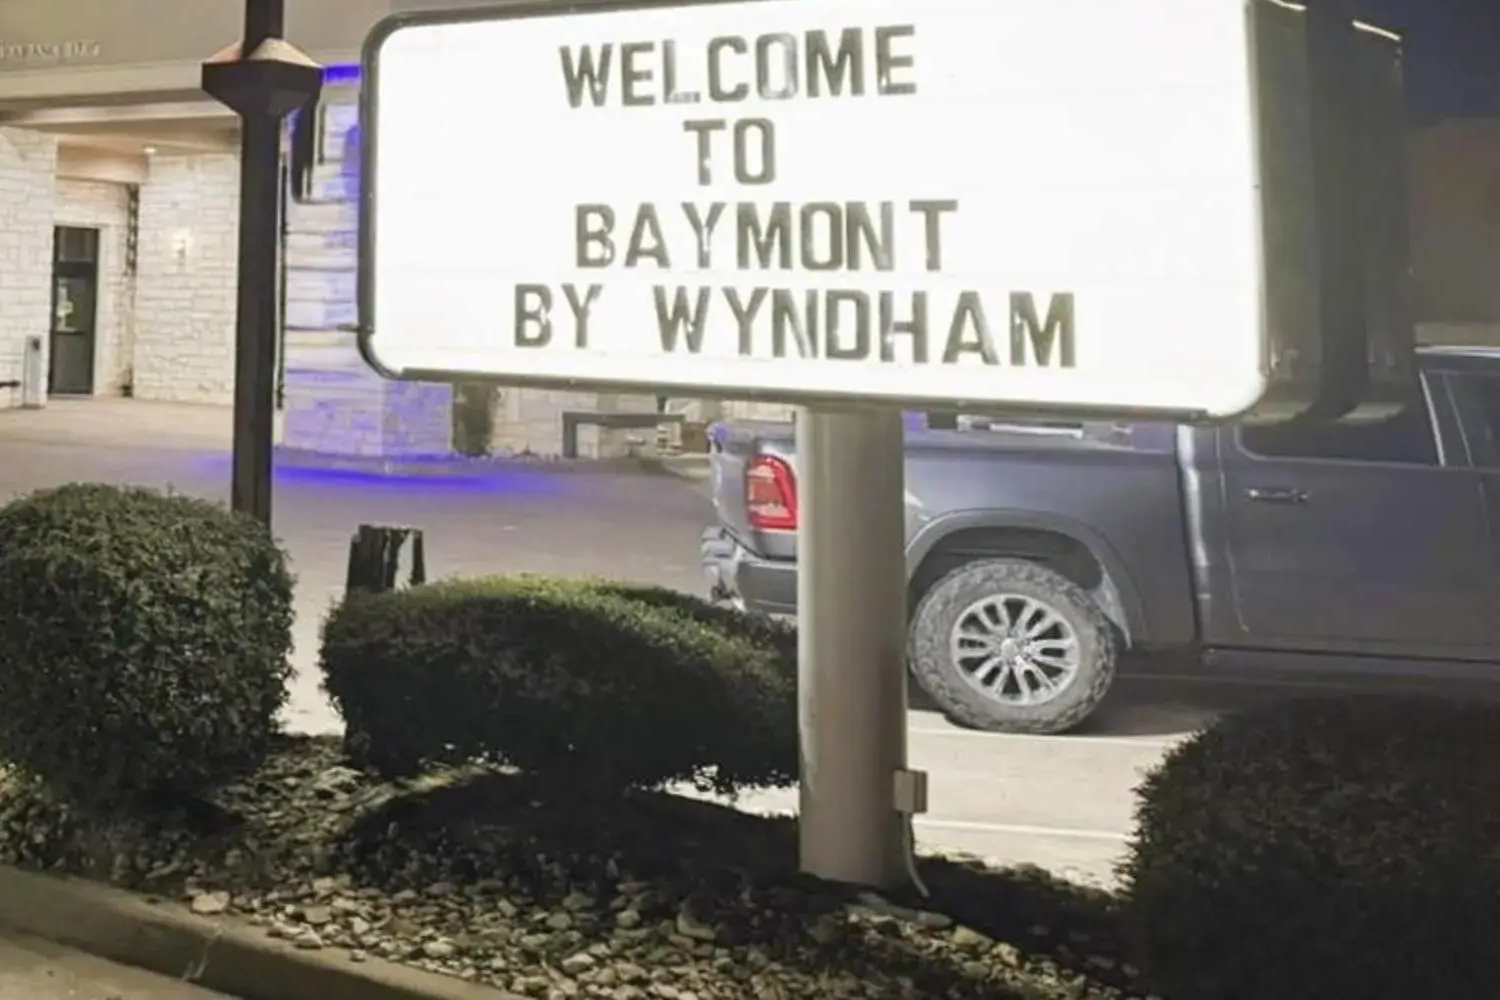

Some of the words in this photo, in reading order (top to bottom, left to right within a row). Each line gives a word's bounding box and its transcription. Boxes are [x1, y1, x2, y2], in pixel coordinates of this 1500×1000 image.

[559, 24, 918, 108] WELCOME
[682, 117, 776, 187] TO
[574, 199, 959, 272] BAYMONT
[513, 283, 603, 349] BY
[653, 285, 1076, 368] WYNDHAM
